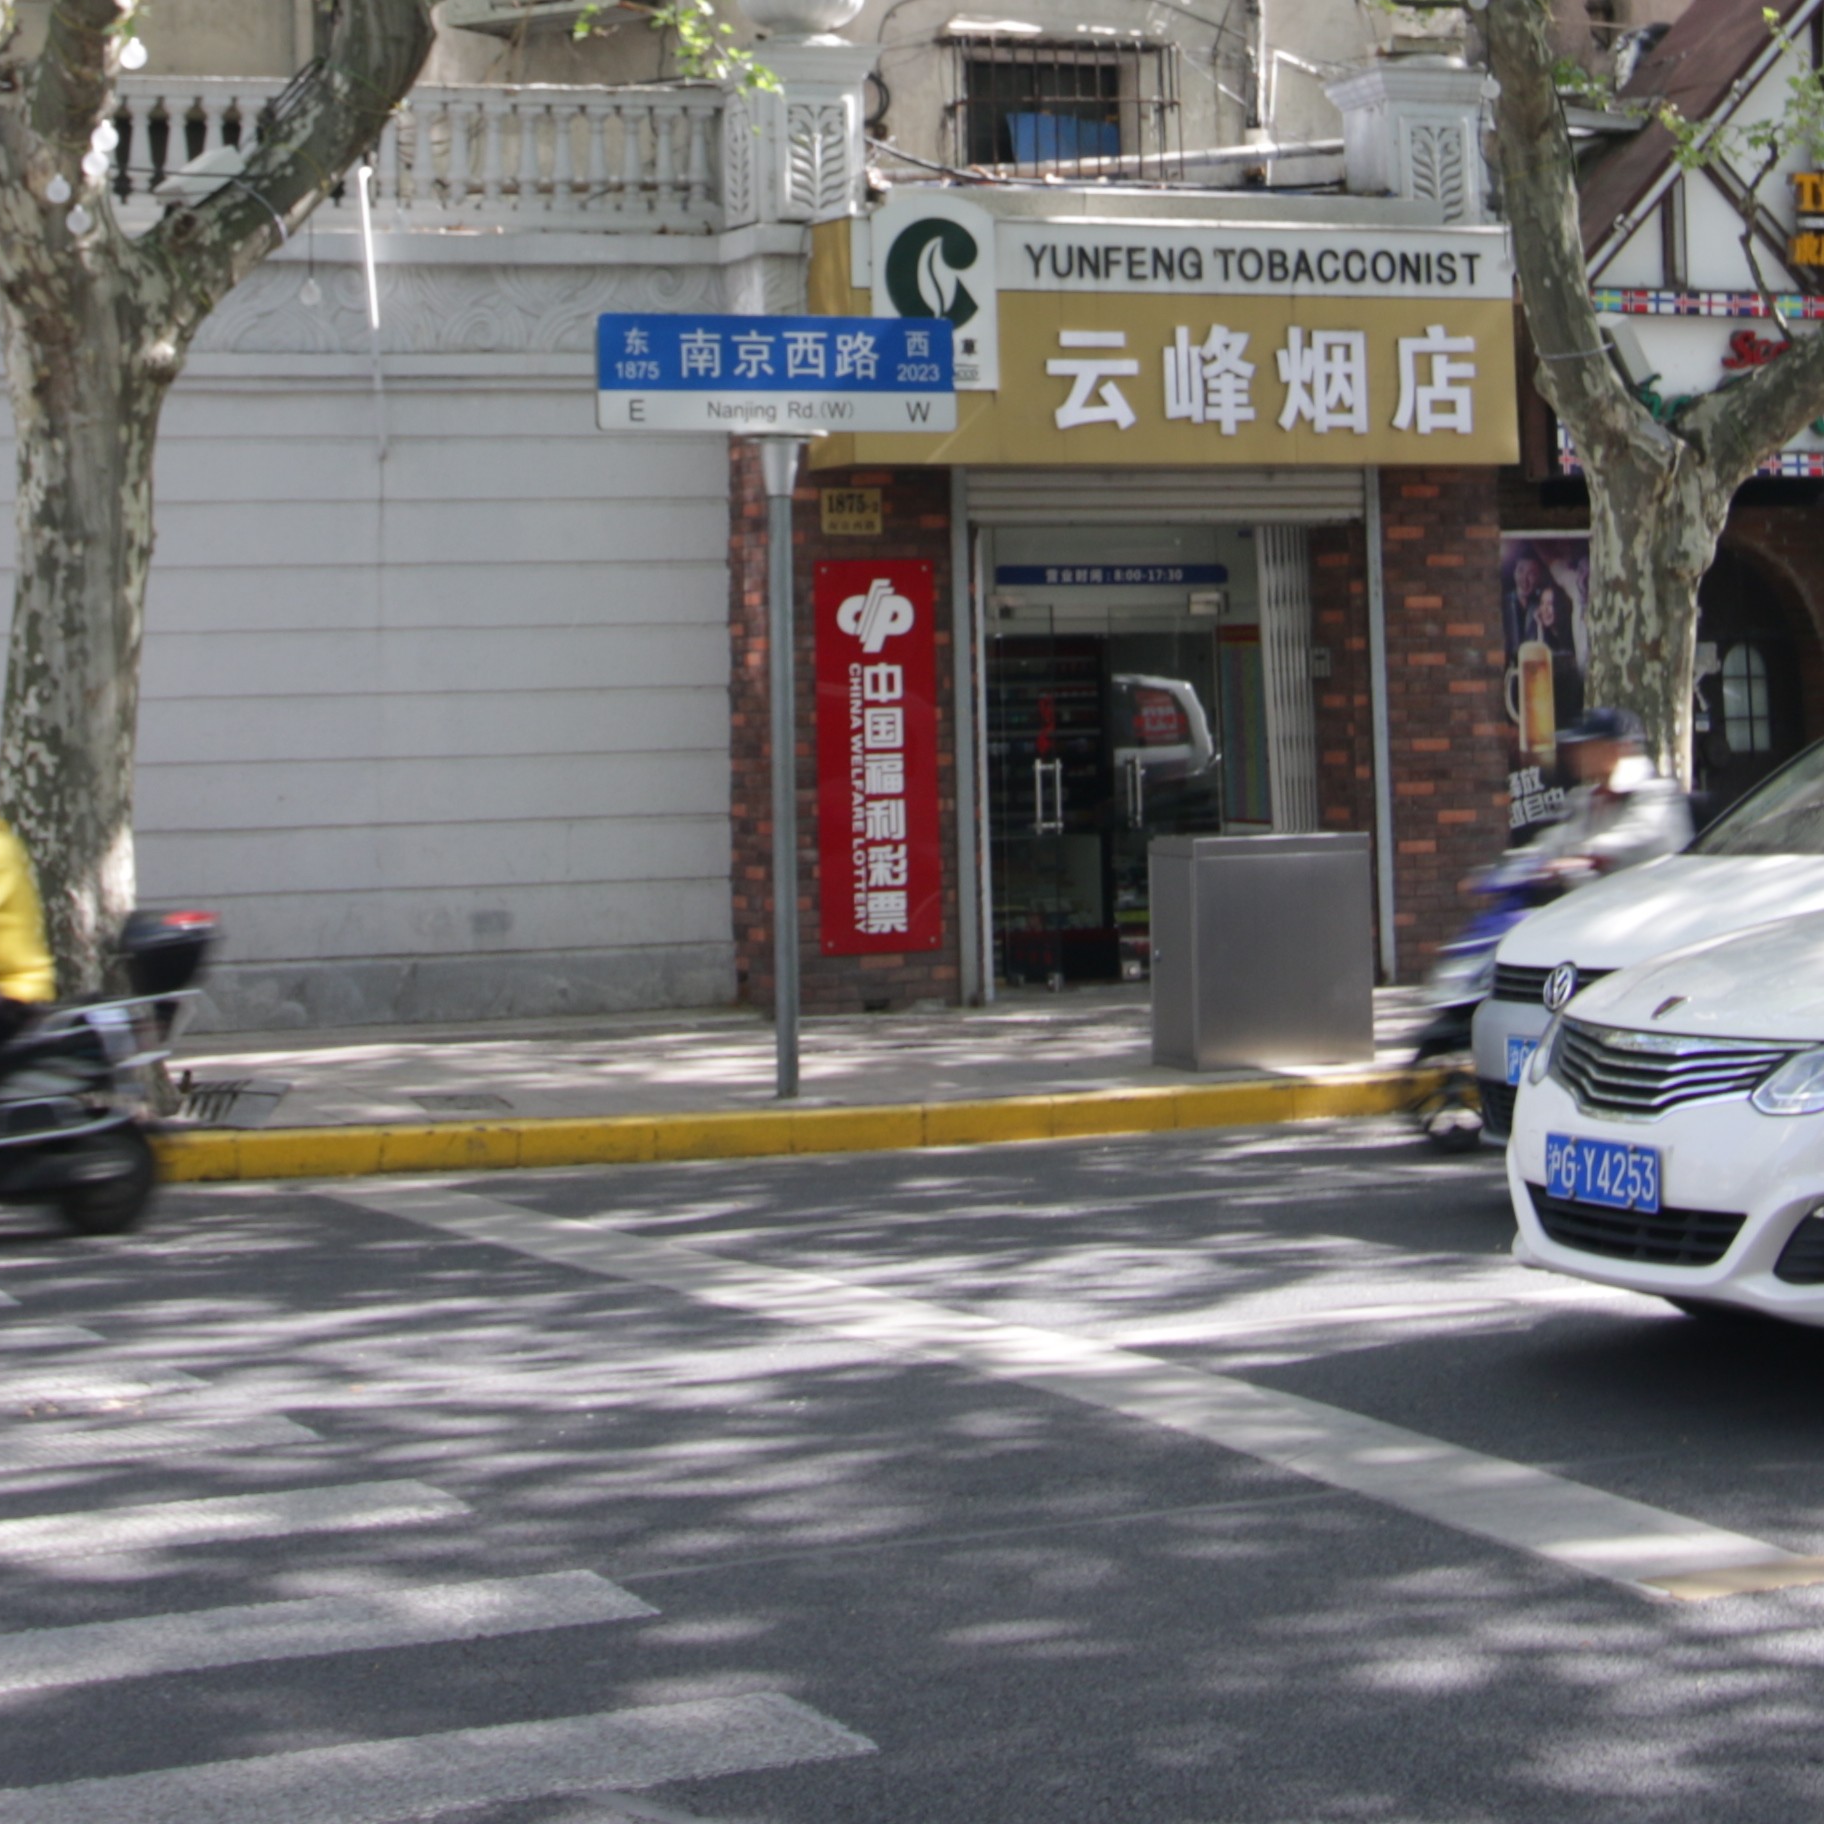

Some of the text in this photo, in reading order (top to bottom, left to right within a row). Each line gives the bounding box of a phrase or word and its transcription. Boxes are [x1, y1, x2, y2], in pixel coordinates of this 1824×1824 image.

[1024, 243, 1481, 287] YUNFENG TOBACCONIST
[624, 327, 650, 356] 东
[679, 328, 879, 379] 南京西路
[904, 330, 930, 358] 西
[614, 360, 660, 380] 1875
[896, 363, 940, 383] 2023
[1046, 323, 1476, 436] 云峰烟店
[629, 398, 646, 422] E
[707, 402, 778, 424] Nanjing
[905, 401, 931, 423] W
[849, 663, 868, 933] CHINA WELFARE LOTTERY
[862, 663, 909, 934] 中国福利彩票
